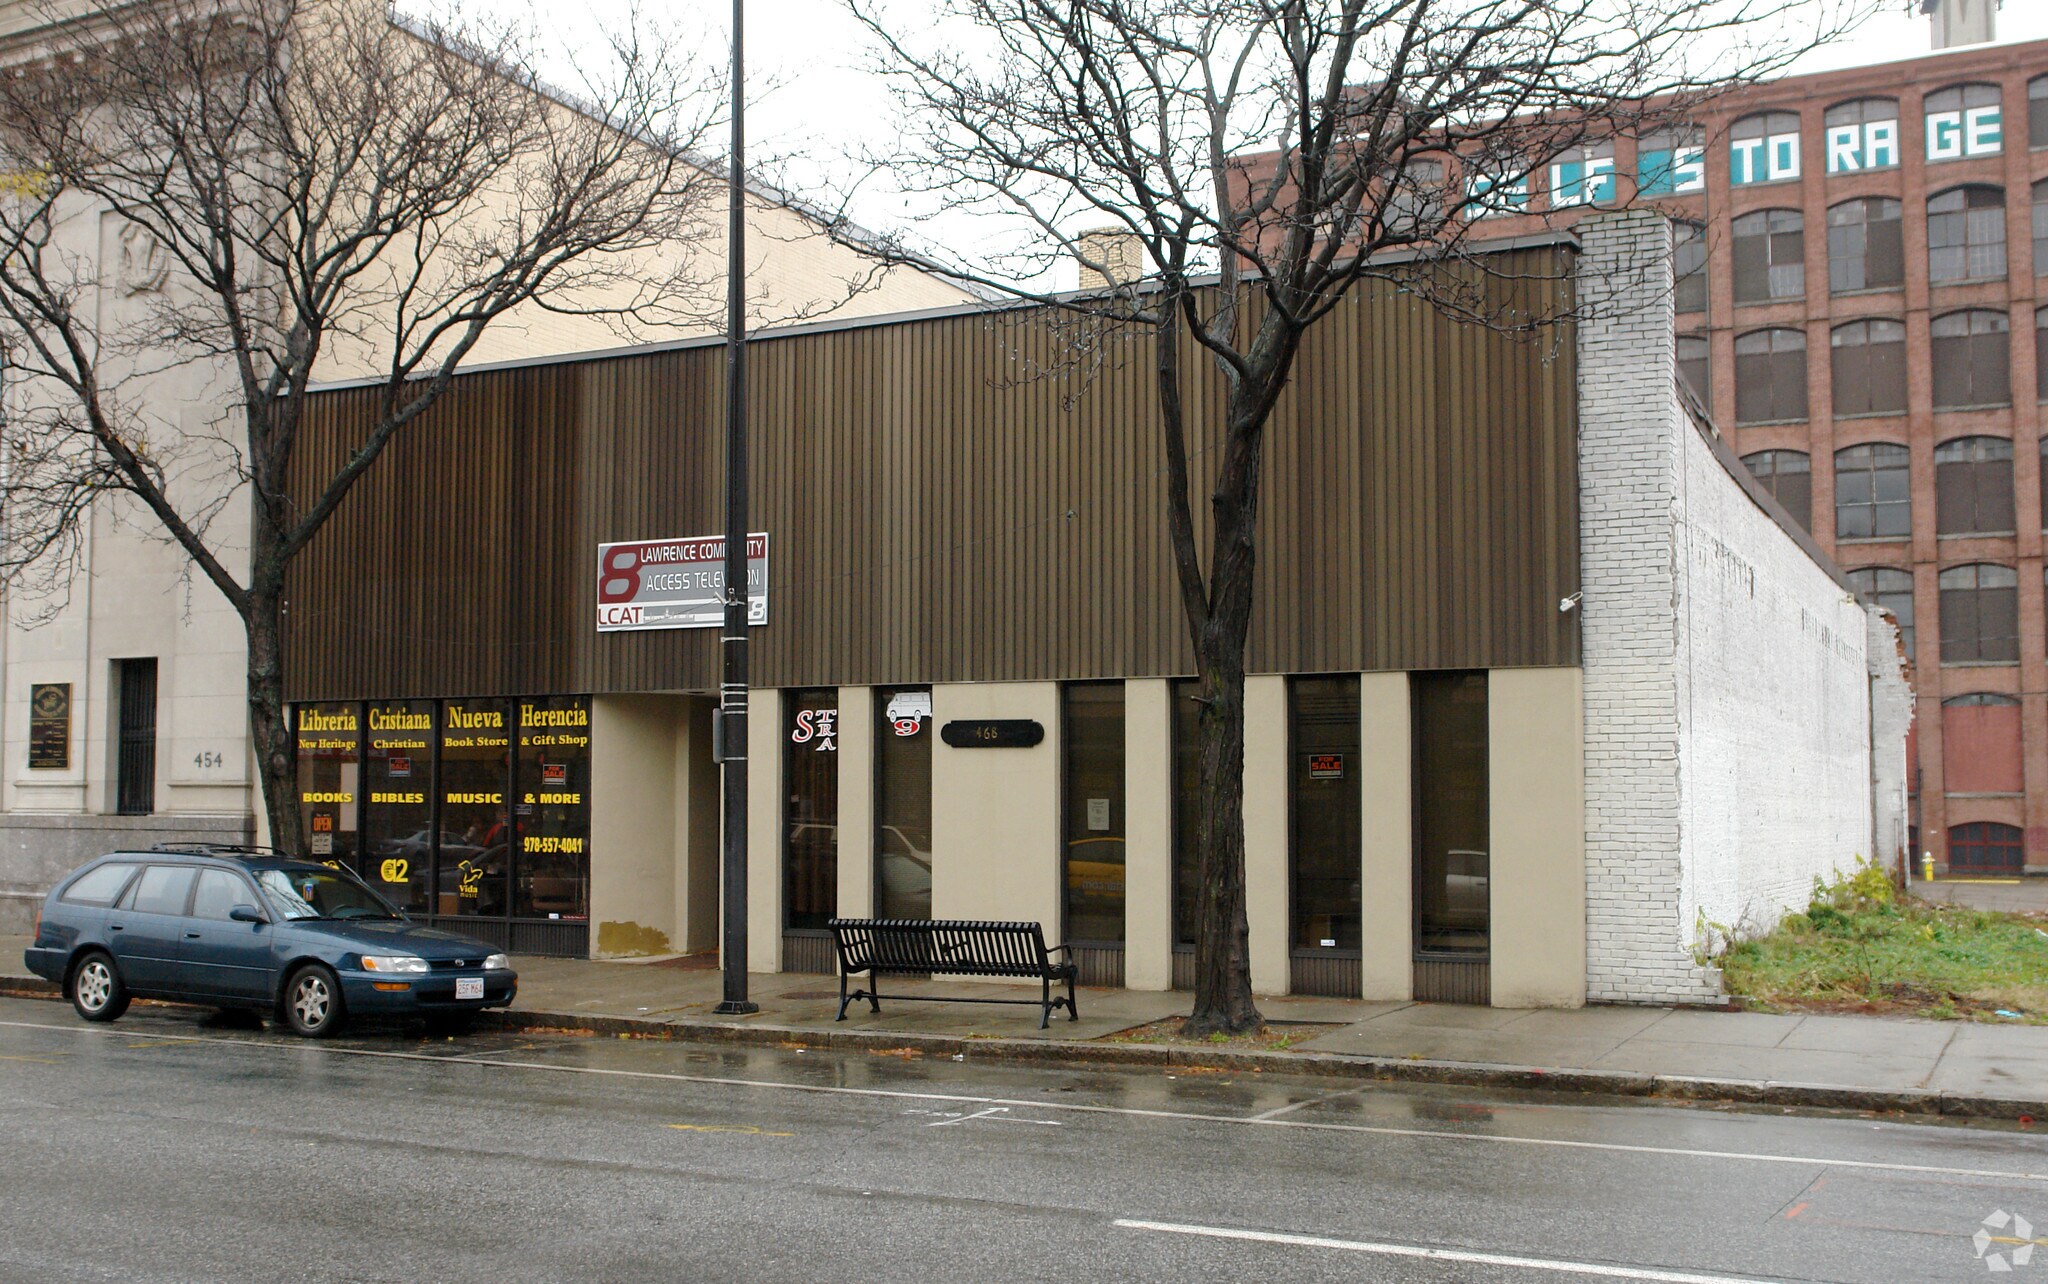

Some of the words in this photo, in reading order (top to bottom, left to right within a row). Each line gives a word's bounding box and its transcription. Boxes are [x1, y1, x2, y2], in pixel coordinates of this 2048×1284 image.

[640, 545, 696, 563] LAWRENCE
[699, 540, 763, 559] COMITY
[599, 546, 643, 604] 8
[646, 573, 690, 592] ACCESS
[598, 607, 643, 625] LCAT
[299, 709, 357, 731] Libreria
[370, 708, 431, 730] Cristiana
[449, 707, 503, 728] Nueva
[521, 702, 587, 727] Herencia
[894, 719, 920, 737] 9
[299, 739, 317, 748] New
[319, 739, 357, 751] Heritage
[374, 740, 426, 748] Christian
[445, 738, 474, 747] Book
[477, 737, 508, 746] Store
[521, 737, 529, 745] &
[533, 735, 556, 745] Gift
[559, 735, 588, 747] Shop
[194, 752, 222, 768] 454
[1312, 762, 1341, 770] SALE
[303, 792, 353, 803] BOOKS
[371, 793, 424, 803] BIBLES
[447, 793, 501, 803] MUSIC
[524, 793, 536, 803] &
[540, 793, 580, 804] MORE
[313, 816, 331, 832] OPEN
[524, 837, 582, 853] 978-557-4041
[459, 884, 479, 893] Vida
